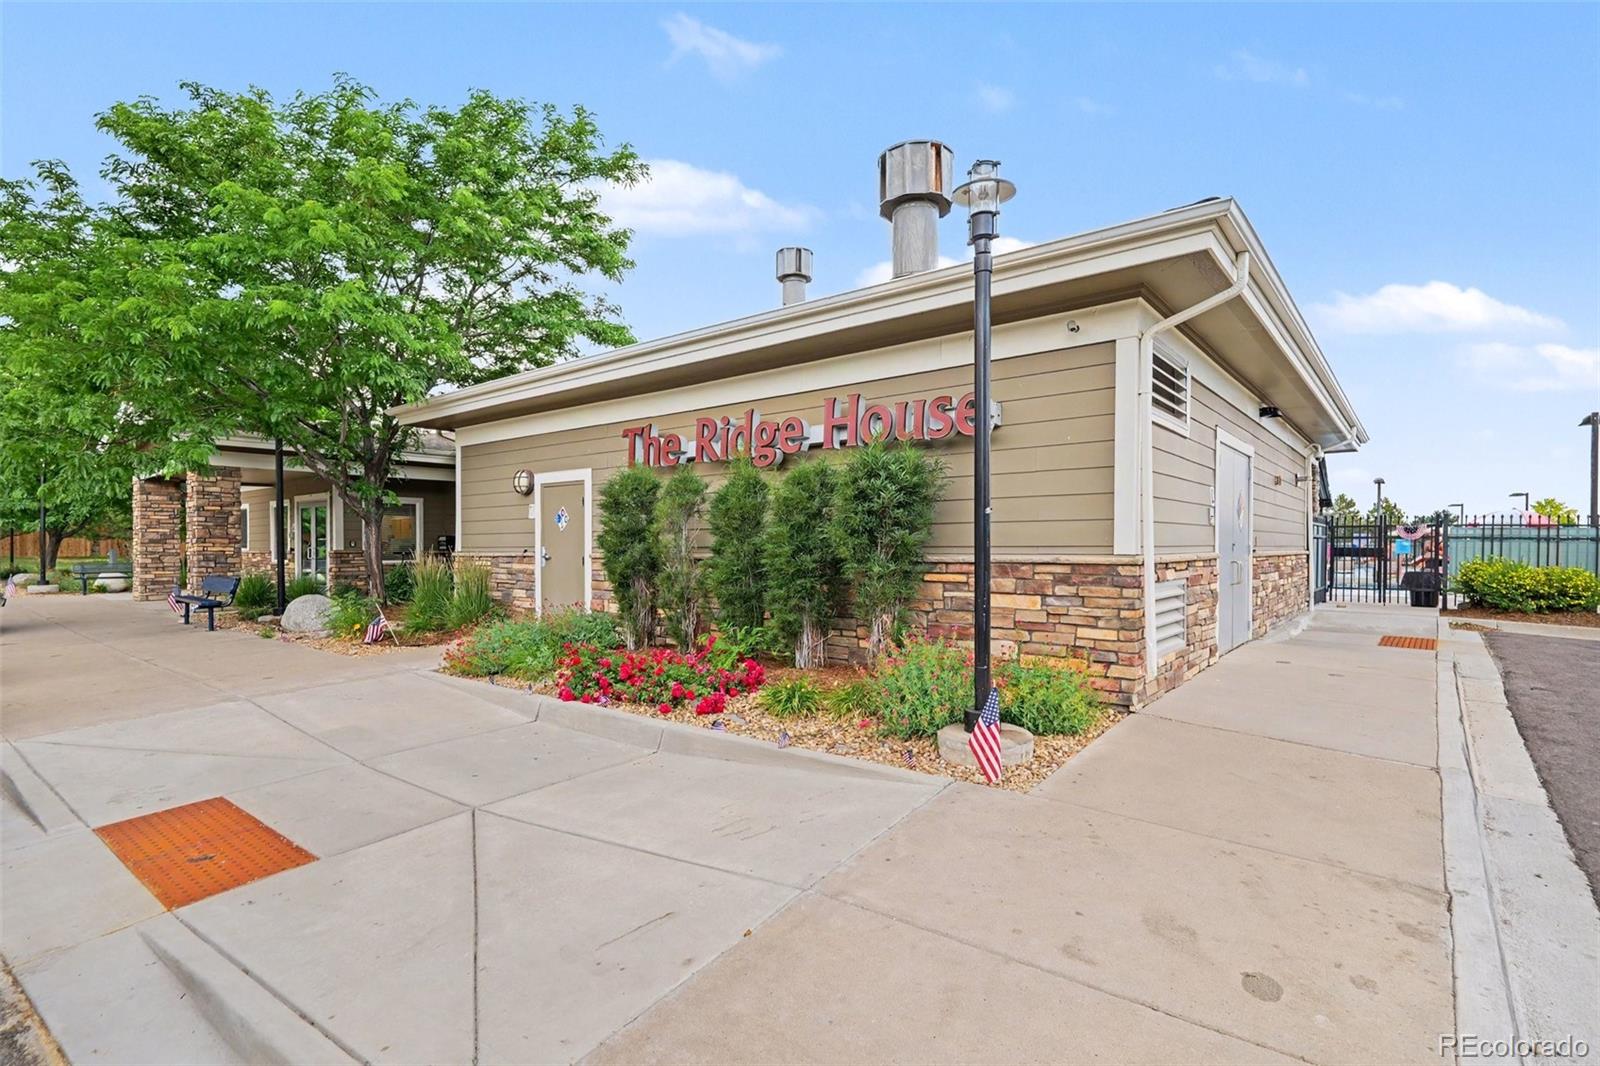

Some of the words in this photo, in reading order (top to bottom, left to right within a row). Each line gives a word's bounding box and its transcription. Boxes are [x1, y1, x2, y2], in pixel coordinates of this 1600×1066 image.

[622, 423, 682, 468] The
[694, 408, 804, 469] Ridge
[823, 393, 975, 449] House
